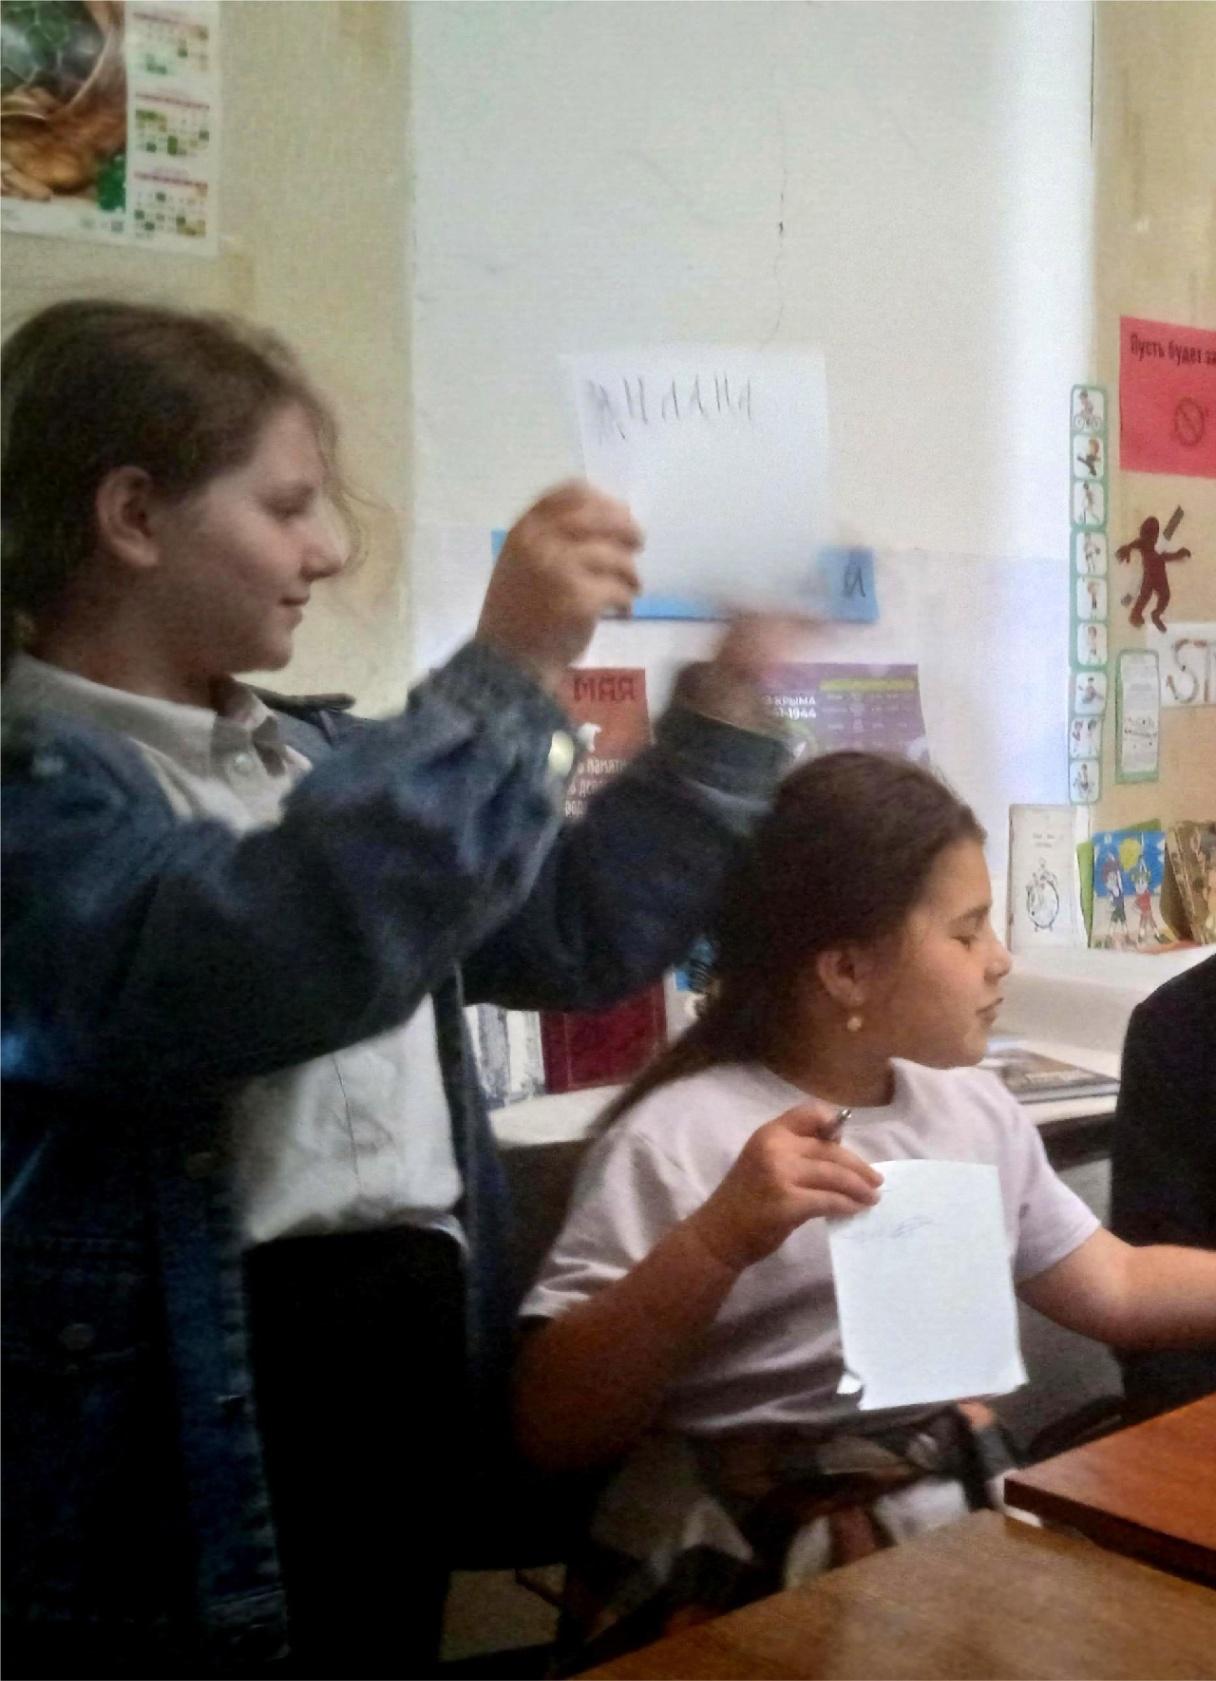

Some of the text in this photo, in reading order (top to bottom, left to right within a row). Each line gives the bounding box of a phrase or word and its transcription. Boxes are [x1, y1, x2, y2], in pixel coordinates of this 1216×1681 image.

[1130, 332, 1165, 362] Пусть
[1167, 340, 1202, 367] будет
[574, 675, 635, 701] МАЯ
